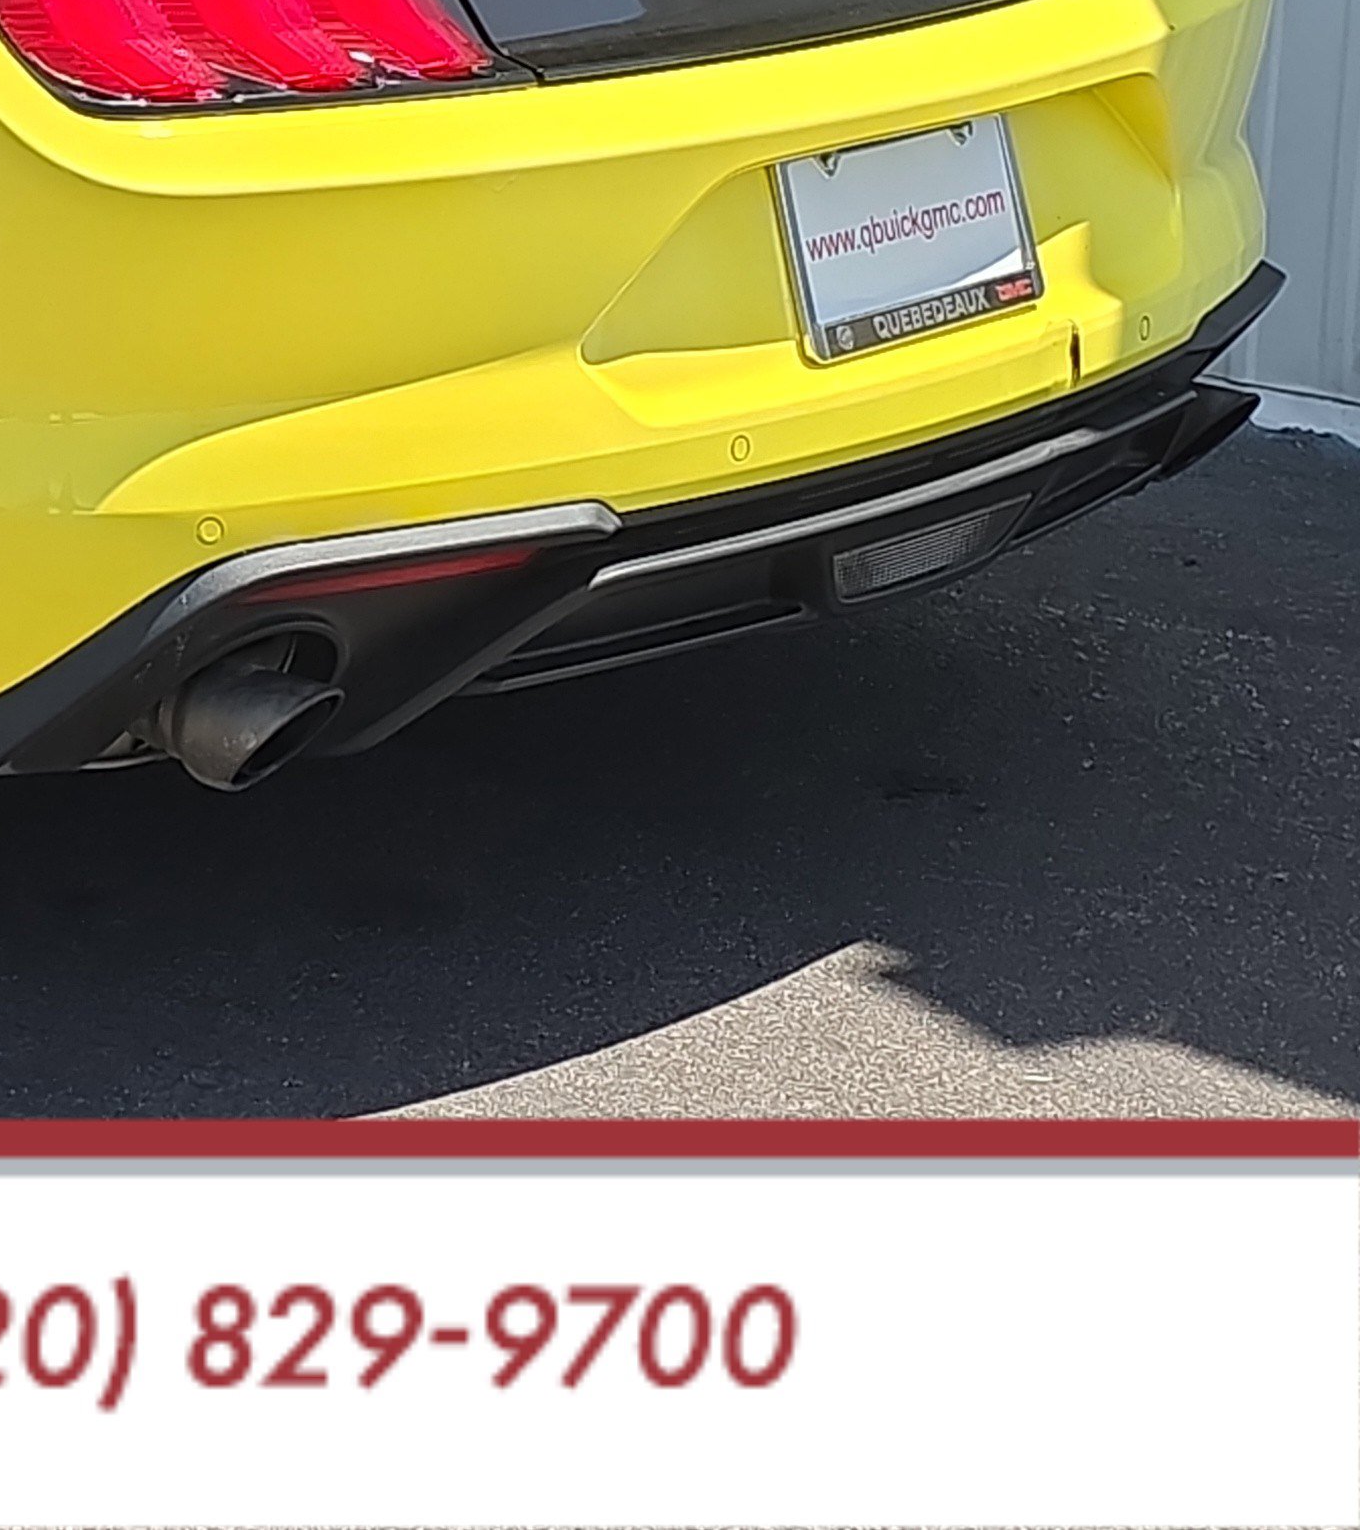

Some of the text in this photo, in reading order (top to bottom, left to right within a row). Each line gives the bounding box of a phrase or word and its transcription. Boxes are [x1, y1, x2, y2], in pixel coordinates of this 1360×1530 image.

[805, 190, 1006, 262] www.qbuickgmc.com
[872, 277, 1034, 341] QUEBEDEAUX GMC
